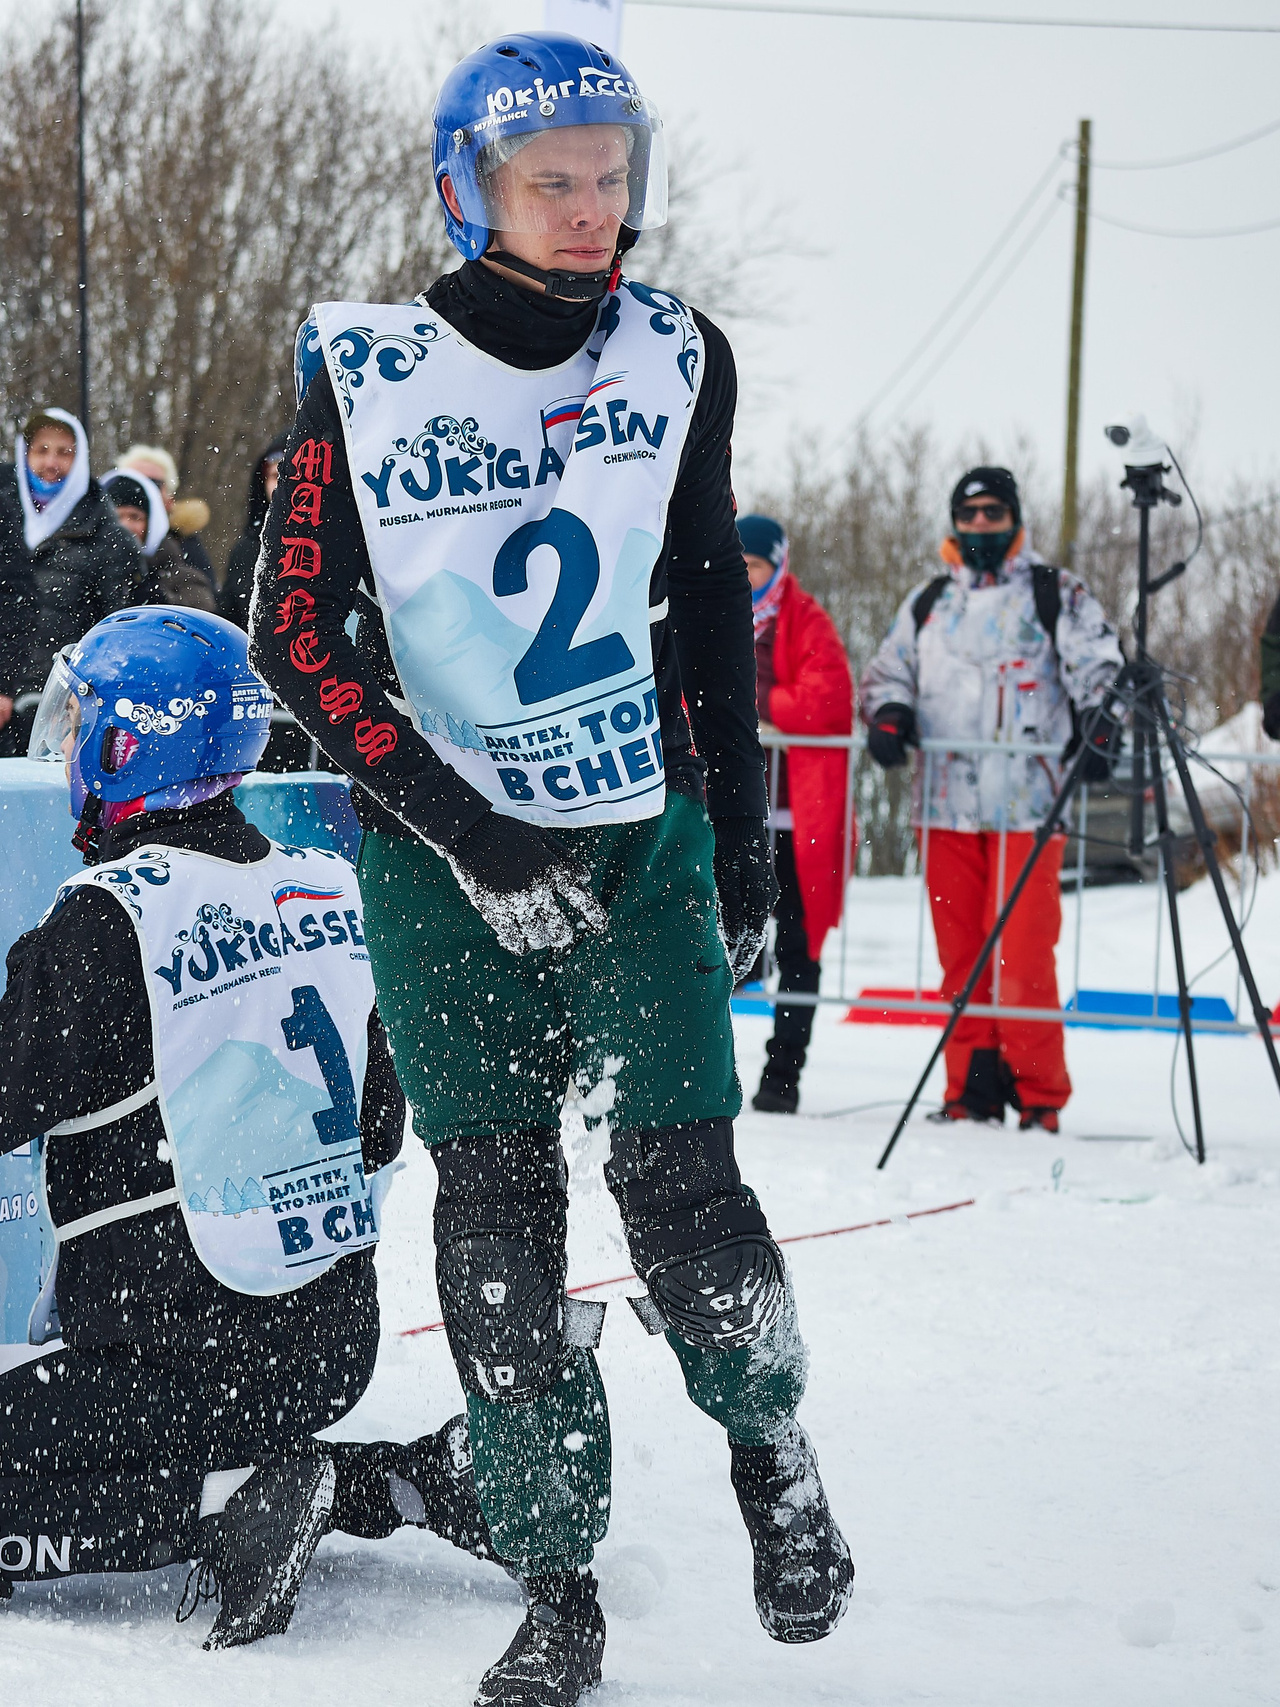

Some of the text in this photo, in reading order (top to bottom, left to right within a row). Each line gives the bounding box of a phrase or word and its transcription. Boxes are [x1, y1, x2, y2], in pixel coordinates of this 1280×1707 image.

[486, 78, 642, 118] ЮКИГАССЕ
[474, 109, 528, 133] МУРМАНСК
[379, 498, 522, 528] RUSSIA, MURMANSK REGION
[493, 507, 635, 706] 2
[233, 704, 244, 720] В
[484, 735, 520, 750] ДЛЯ
[522, 724, 570, 747] ТЕХ,
[490, 742, 574, 763] КТО ЗНАЕТ
[497, 767, 535, 801] В
[173, 993, 209, 1012] RUSSIA,
[210, 972, 258, 997] MURMANSK
[281, 985, 361, 1146] 1
[269, 1177, 309, 1202] ДЛЯ
[272, 1185, 350, 1215] КТО ЗНАЕТ
[277, 1216, 314, 1256] В
